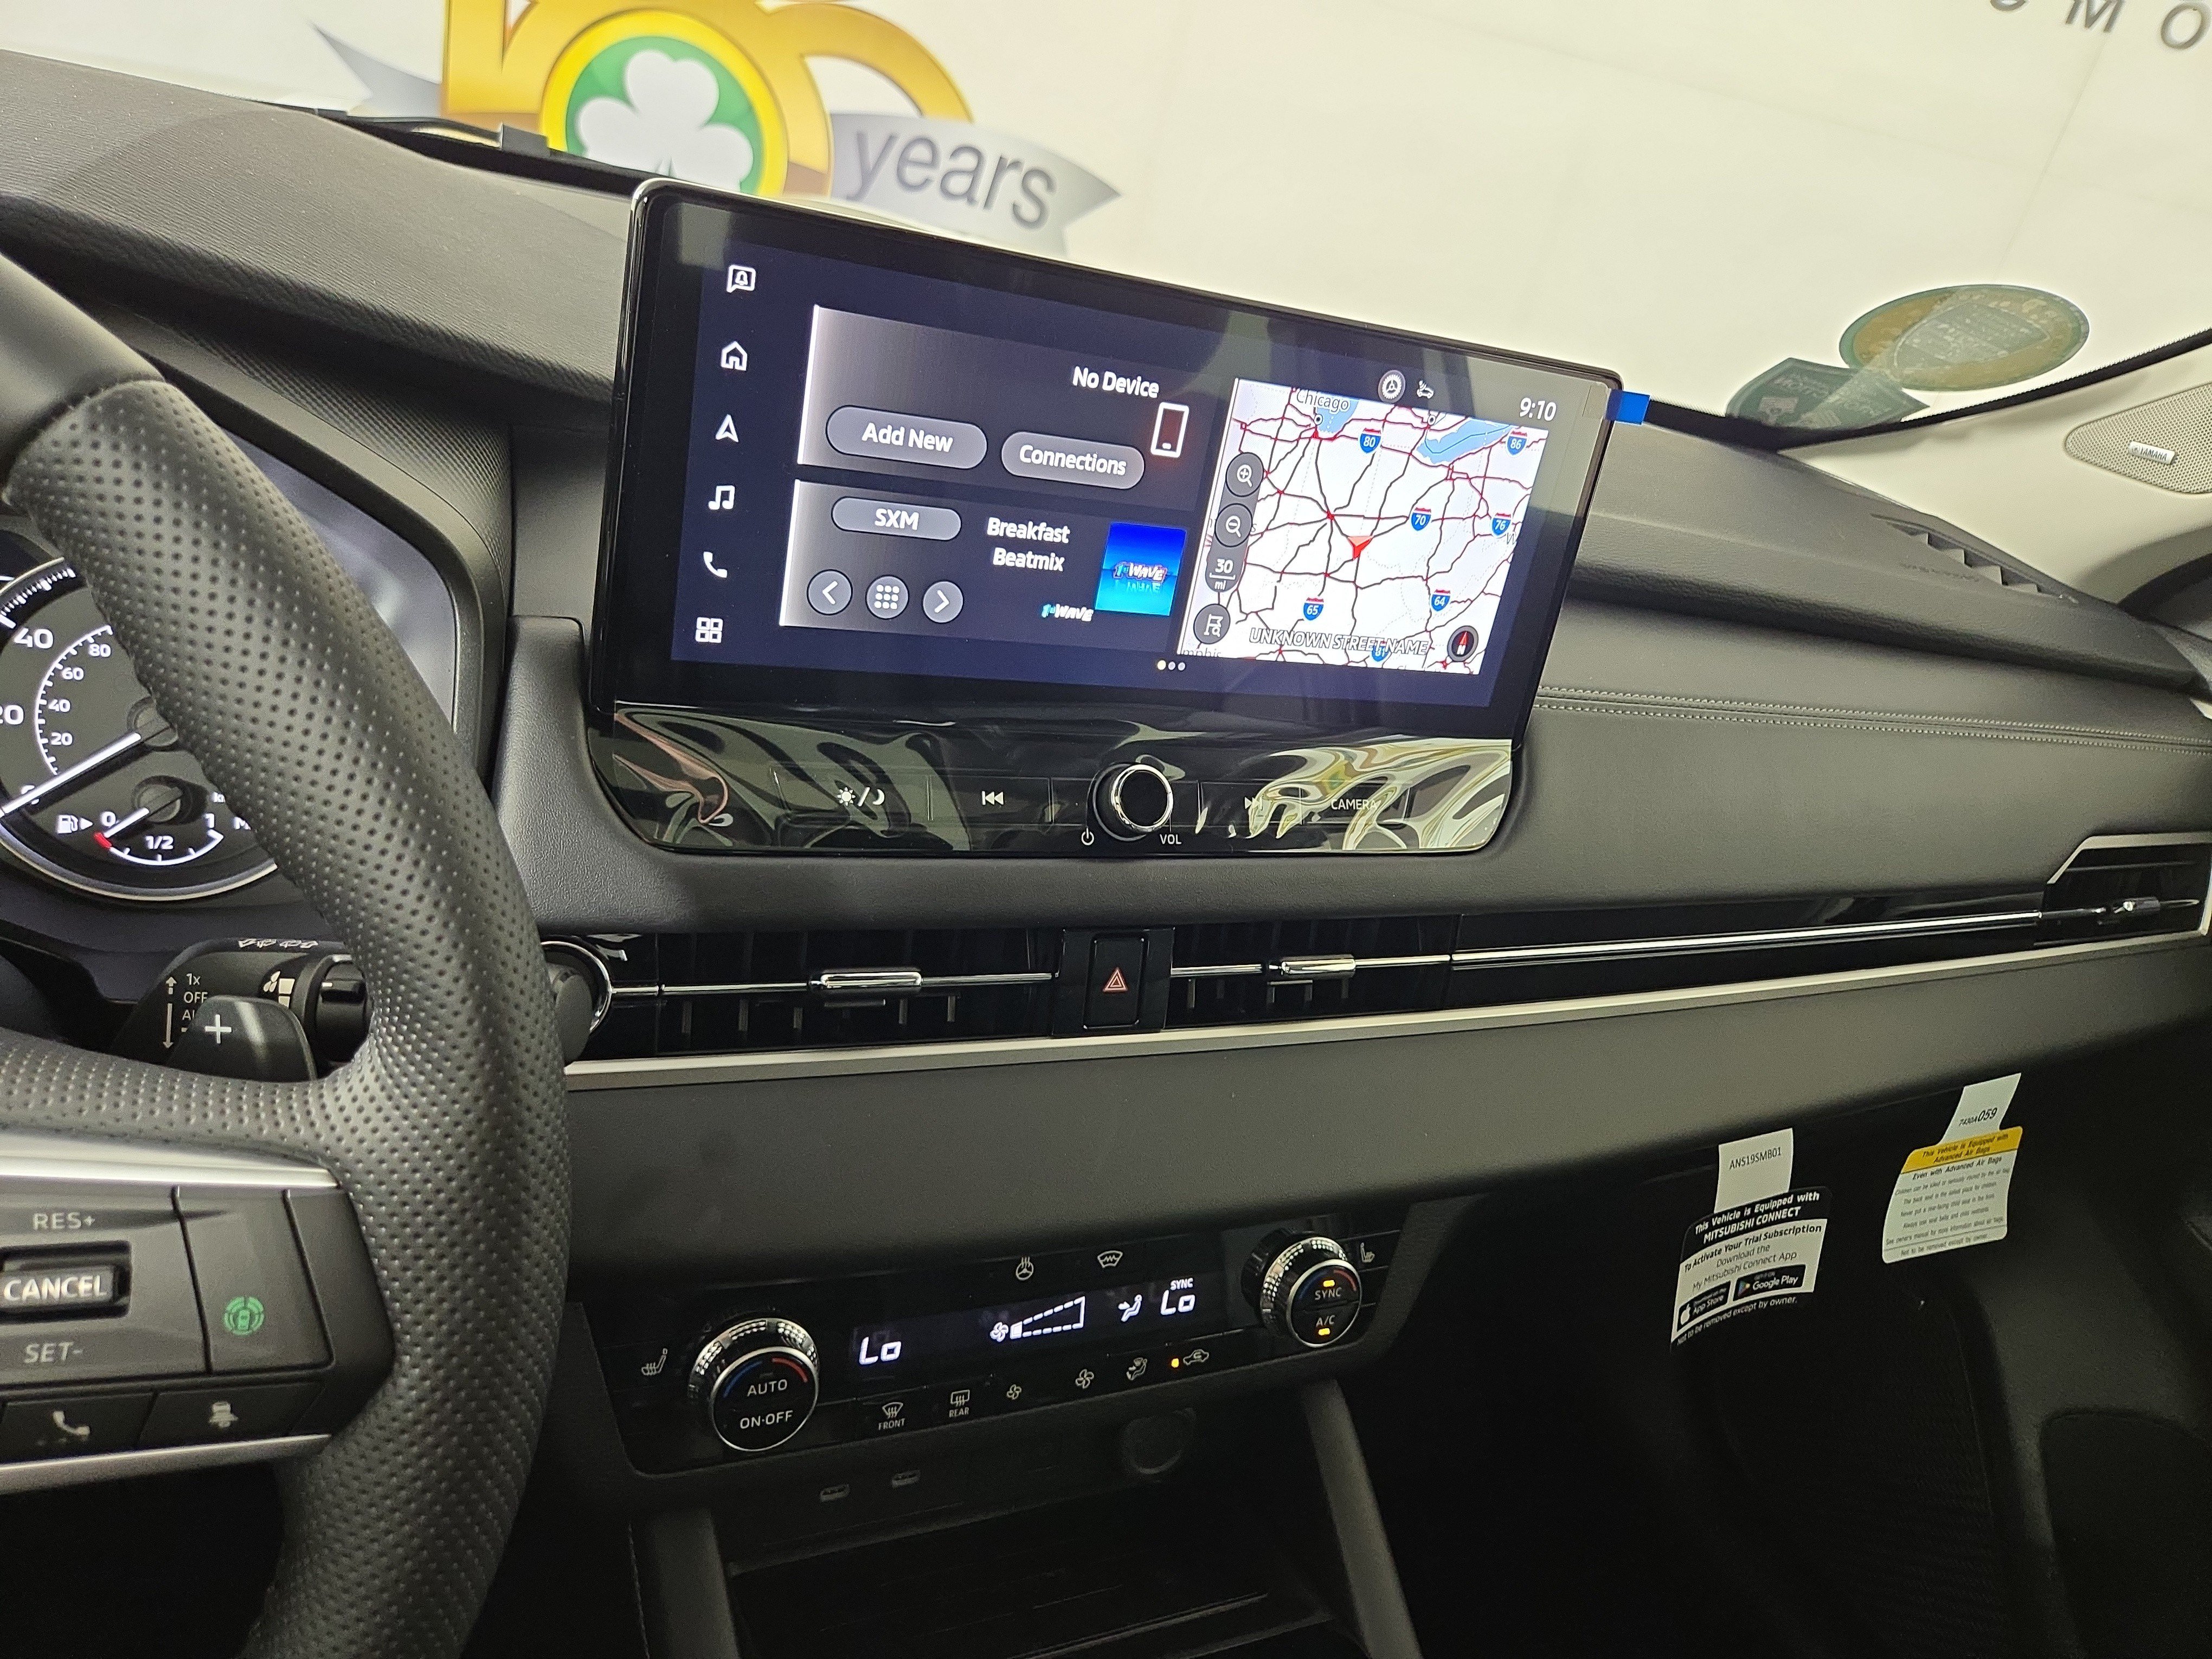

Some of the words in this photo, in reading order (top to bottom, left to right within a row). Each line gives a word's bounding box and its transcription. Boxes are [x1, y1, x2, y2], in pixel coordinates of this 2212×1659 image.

[847, 130, 1058, 230] years
[1073, 366, 1099, 389] No
[1102, 371, 1159, 398] Device
[1296, 389, 1349, 412] Chicago
[1519, 397, 1557, 421] 9:10
[862, 423, 904, 448] Add
[908, 429, 954, 452] New
[1363, 436, 1376, 448] 80
[1510, 438, 1522, 449] 86
[1020, 444, 1126, 475] Connections
[2140, 446, 2168, 461] YAMAHA
[874, 509, 919, 530] SXM
[1414, 515, 1426, 526] 70
[1495, 520, 1506, 531] 76
[987, 518, 1070, 544] Breakfast
[993, 548, 1065, 573] Beatmix
[1215, 558, 1233, 574] 30
[1434, 596, 1445, 607] 64
[1307, 604, 1319, 616] 65
[14, 628, 54, 649] 40
[1249, 627, 1332, 649] UNKNOWN
[1333, 634, 1386, 651] STREET
[1385, 639, 1429, 655] NAME
[88, 644, 111, 657] 80
[62, 667, 84, 680] 60
[48, 699, 70, 712] 40
[0, 704, 24, 725] 0
[51, 732, 73, 745] 20
[1331, 799, 1378, 811] CAMERA
[145, 835, 173, 851] 1/2
[1160, 834, 1182, 845] VOL
[186, 973, 201, 986] 1x
[184, 992, 208, 1004] OFF
[33, 1212, 96, 1230] RES+
[1695, 1221, 1708, 1235] This
[1712, 1210, 1741, 1226] Vehicle
[1754, 1194, 1793, 1214] Equipped
[1797, 1192, 1819, 1202] with
[1703, 1217, 1754, 1244] MITSUBISHI
[1756, 1206, 1801, 1225] CONNECT
[1684, 1264, 1692, 1273] To
[1692, 1249, 1722, 1268] Activate
[1725, 1242, 1742, 1253] Your
[1745, 1233, 1761, 1246] Trial
[1763, 1225, 1822, 1242] Subscription
[1716, 1249, 1754, 1268] Download
[1757, 1245, 1771, 1255] the
[1692, 1281, 1702, 1293] My
[1704, 1264, 1742, 1283] Mitsubishi
[1743, 1255, 1776, 1271] Connect
[1778, 1251, 1797, 1262] App
[4, 1275, 108, 1302] CANCEL
[1170, 1278, 1193, 1290] SYNC
[1752, 1277, 1780, 1291] Google
[1781, 1275, 1798, 1285] Play
[1315, 1287, 1342, 1301] SYNC
[1759, 1299, 1767, 1308] by
[1316, 1315, 1335, 1327] A/C
[24, 1342, 84, 1364] SET-
[747, 1379, 788, 1397] AUTO
[949, 1407, 969, 1418] REAR
[878, 1418, 905, 1430] FRONT
